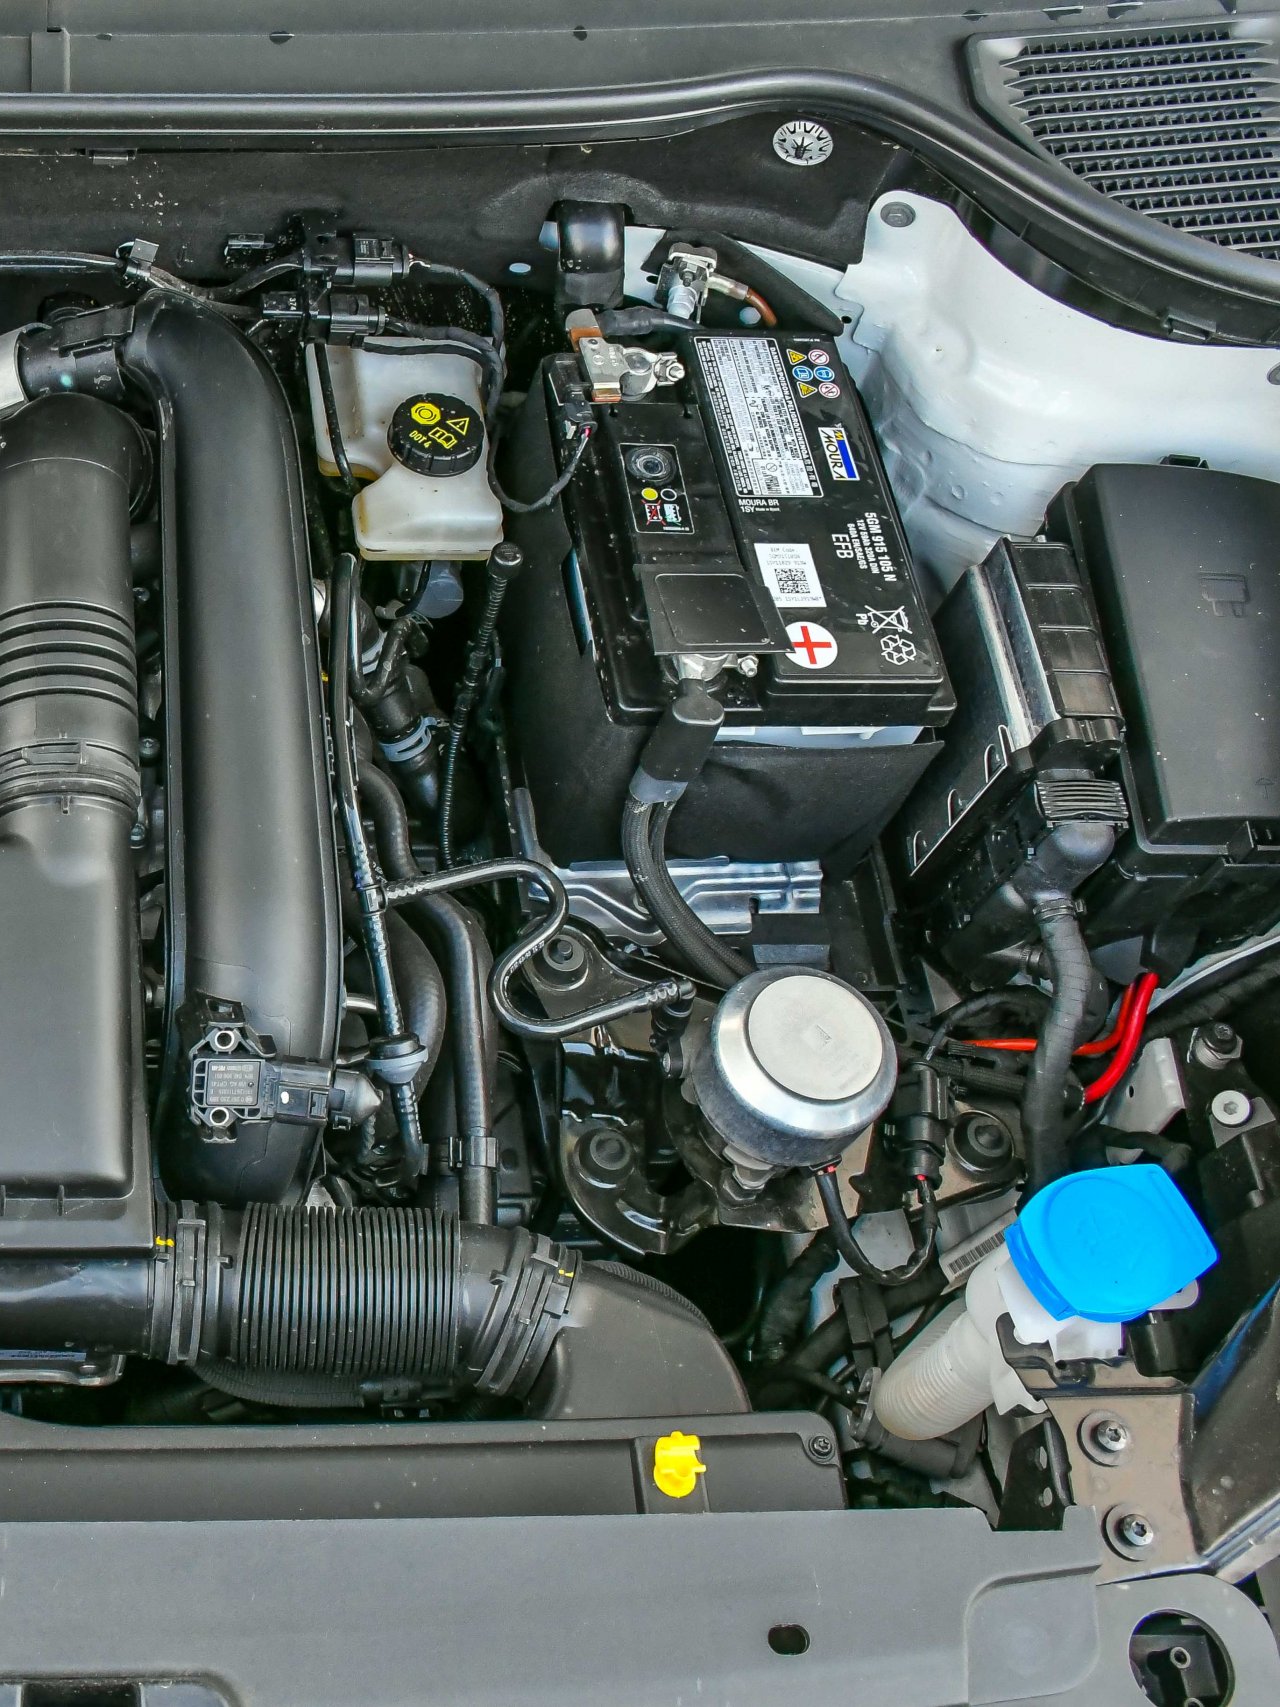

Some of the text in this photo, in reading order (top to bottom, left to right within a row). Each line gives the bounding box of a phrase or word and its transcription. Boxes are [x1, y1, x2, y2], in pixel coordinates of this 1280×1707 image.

[409, 430, 432, 448] DOT 4
[821, 430, 846, 479] MOURA
[738, 498, 767, 506] MOURA
[856, 519, 867, 531] 12V
[831, 533, 855, 559] EFB
[864, 512, 897, 582] 5GM 915 105 N
[865, 547, 876, 562] 320A
[869, 563, 880, 574] DIN
[855, 614, 869, 627] Pb
